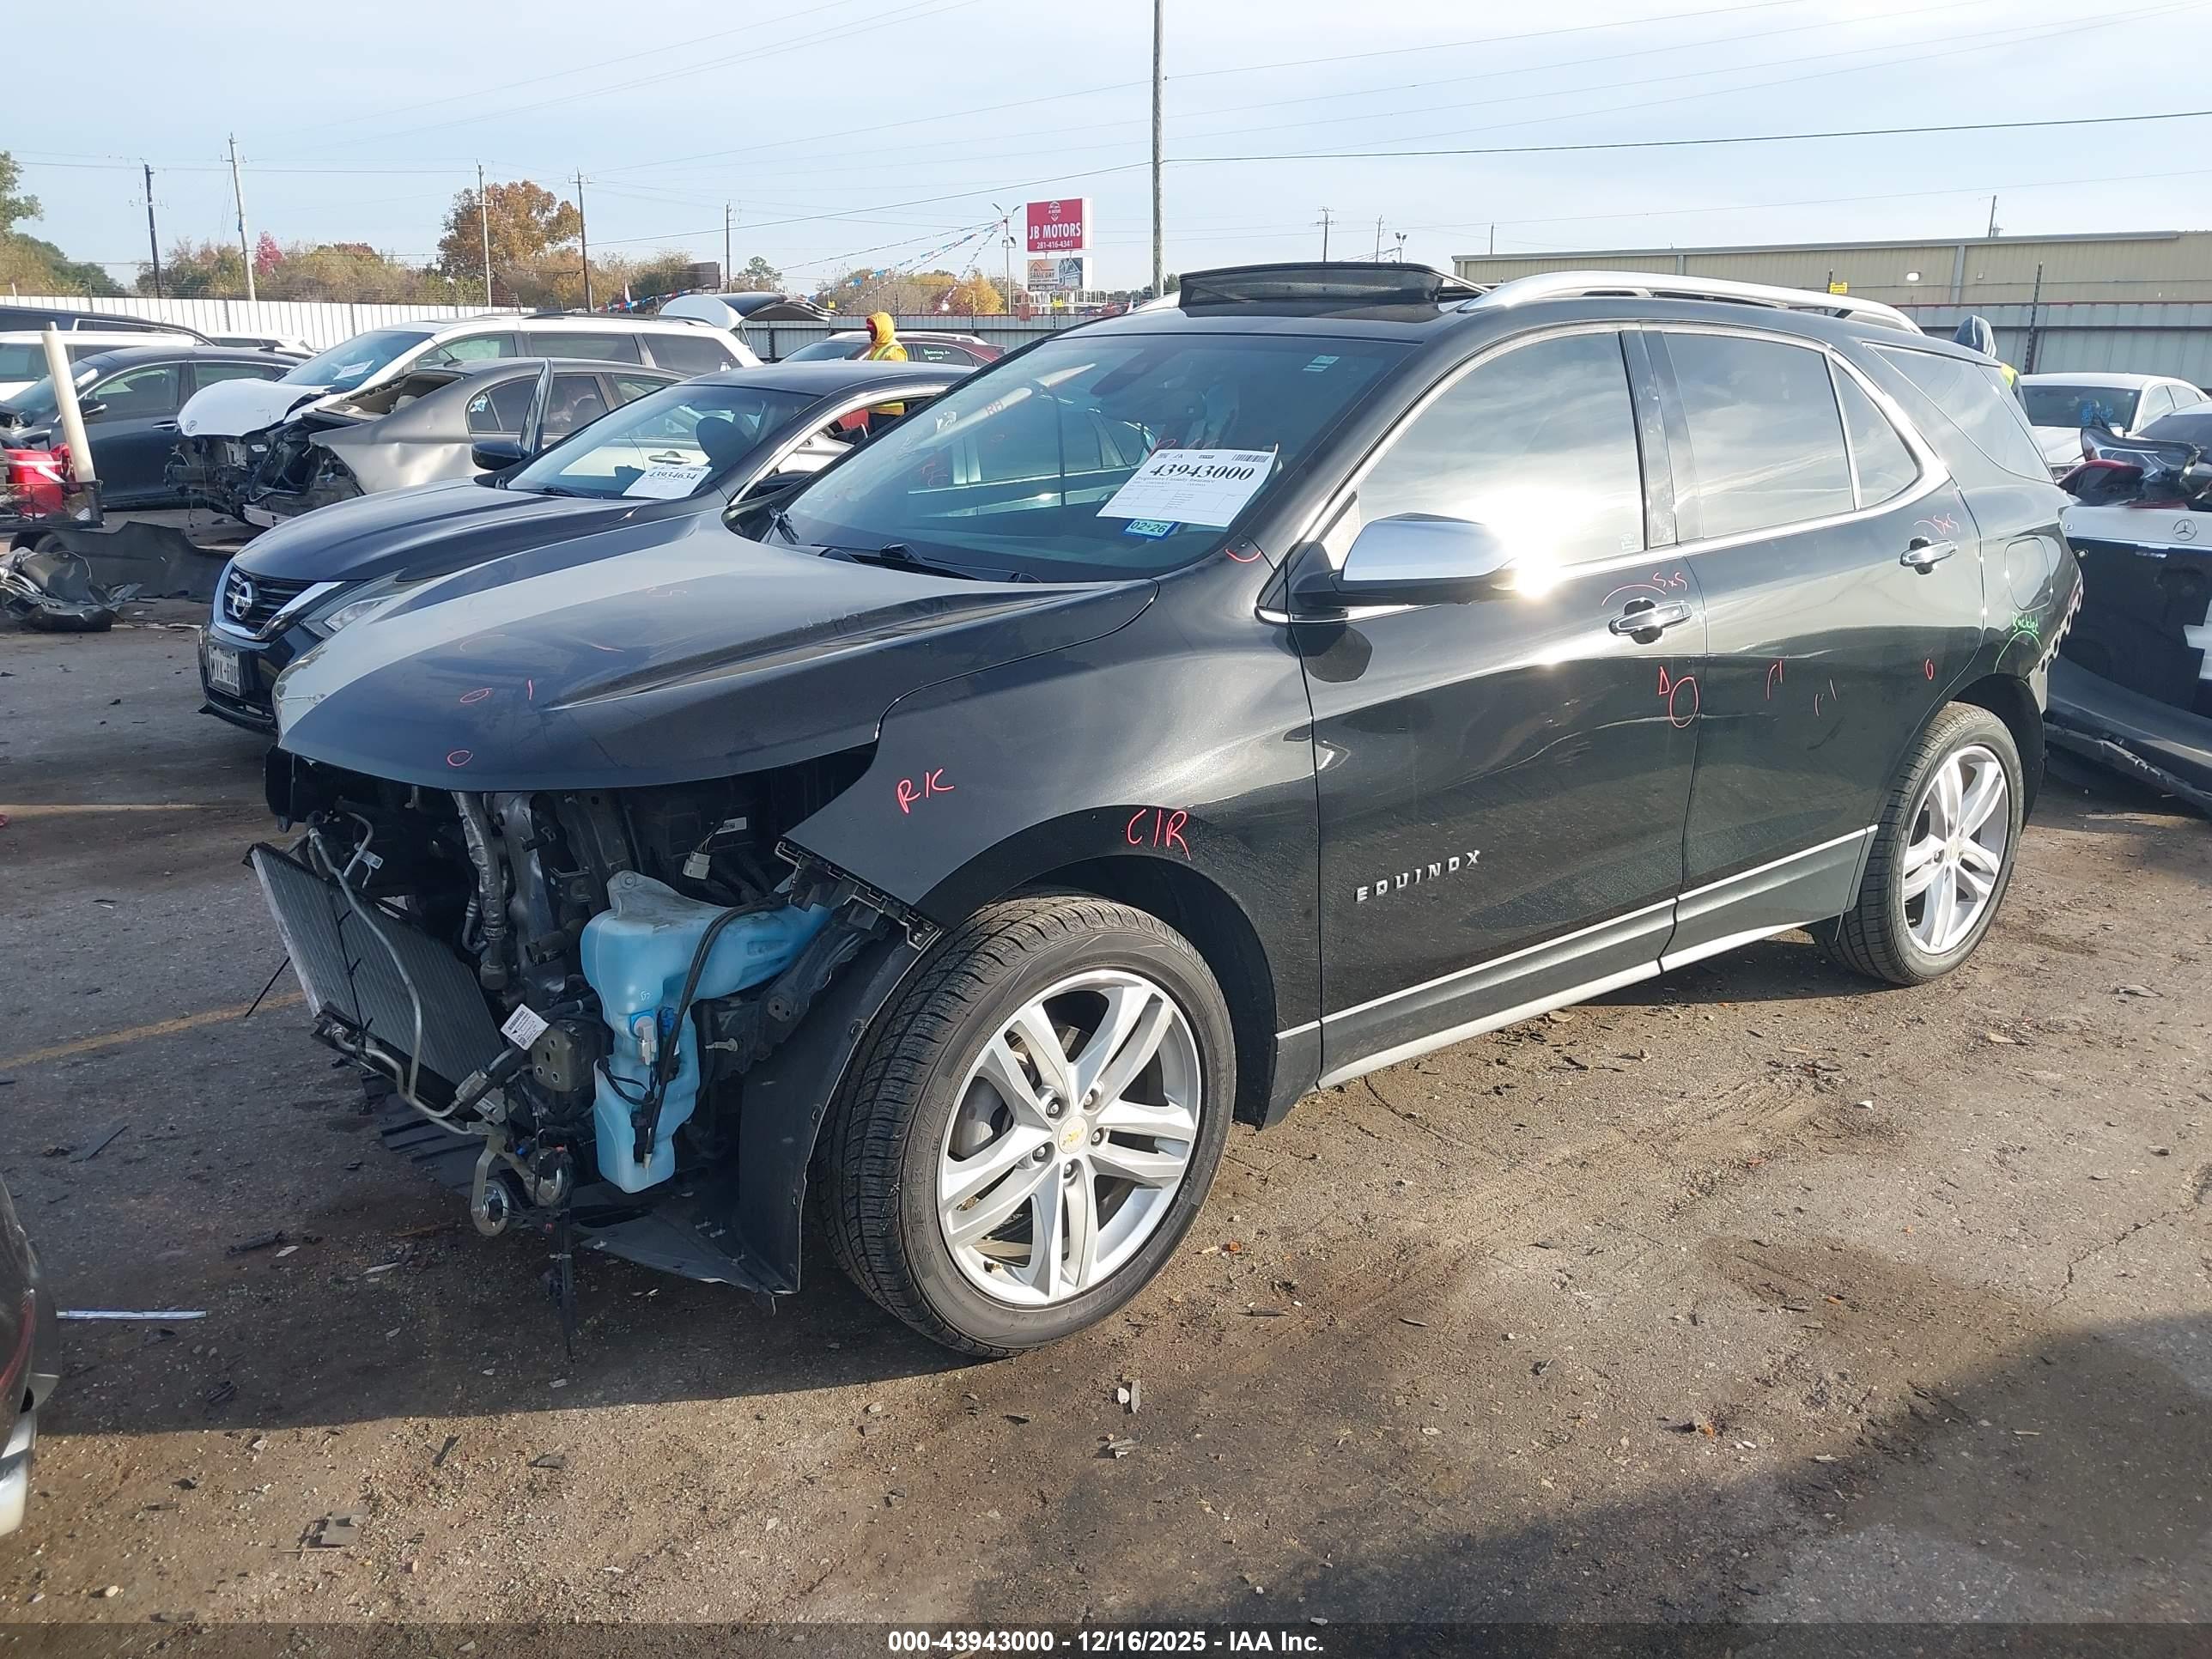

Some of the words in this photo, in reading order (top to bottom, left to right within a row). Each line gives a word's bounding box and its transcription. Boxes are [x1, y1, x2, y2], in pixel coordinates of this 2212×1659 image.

[1029, 225, 1040, 240] JB
[1042, 222, 1081, 239] MOTORS
[1036, 240, 1073, 249] 281-416-4341
[1149, 463, 1255, 481] 43943000
[1355, 850, 1480, 902] EQUINOX
